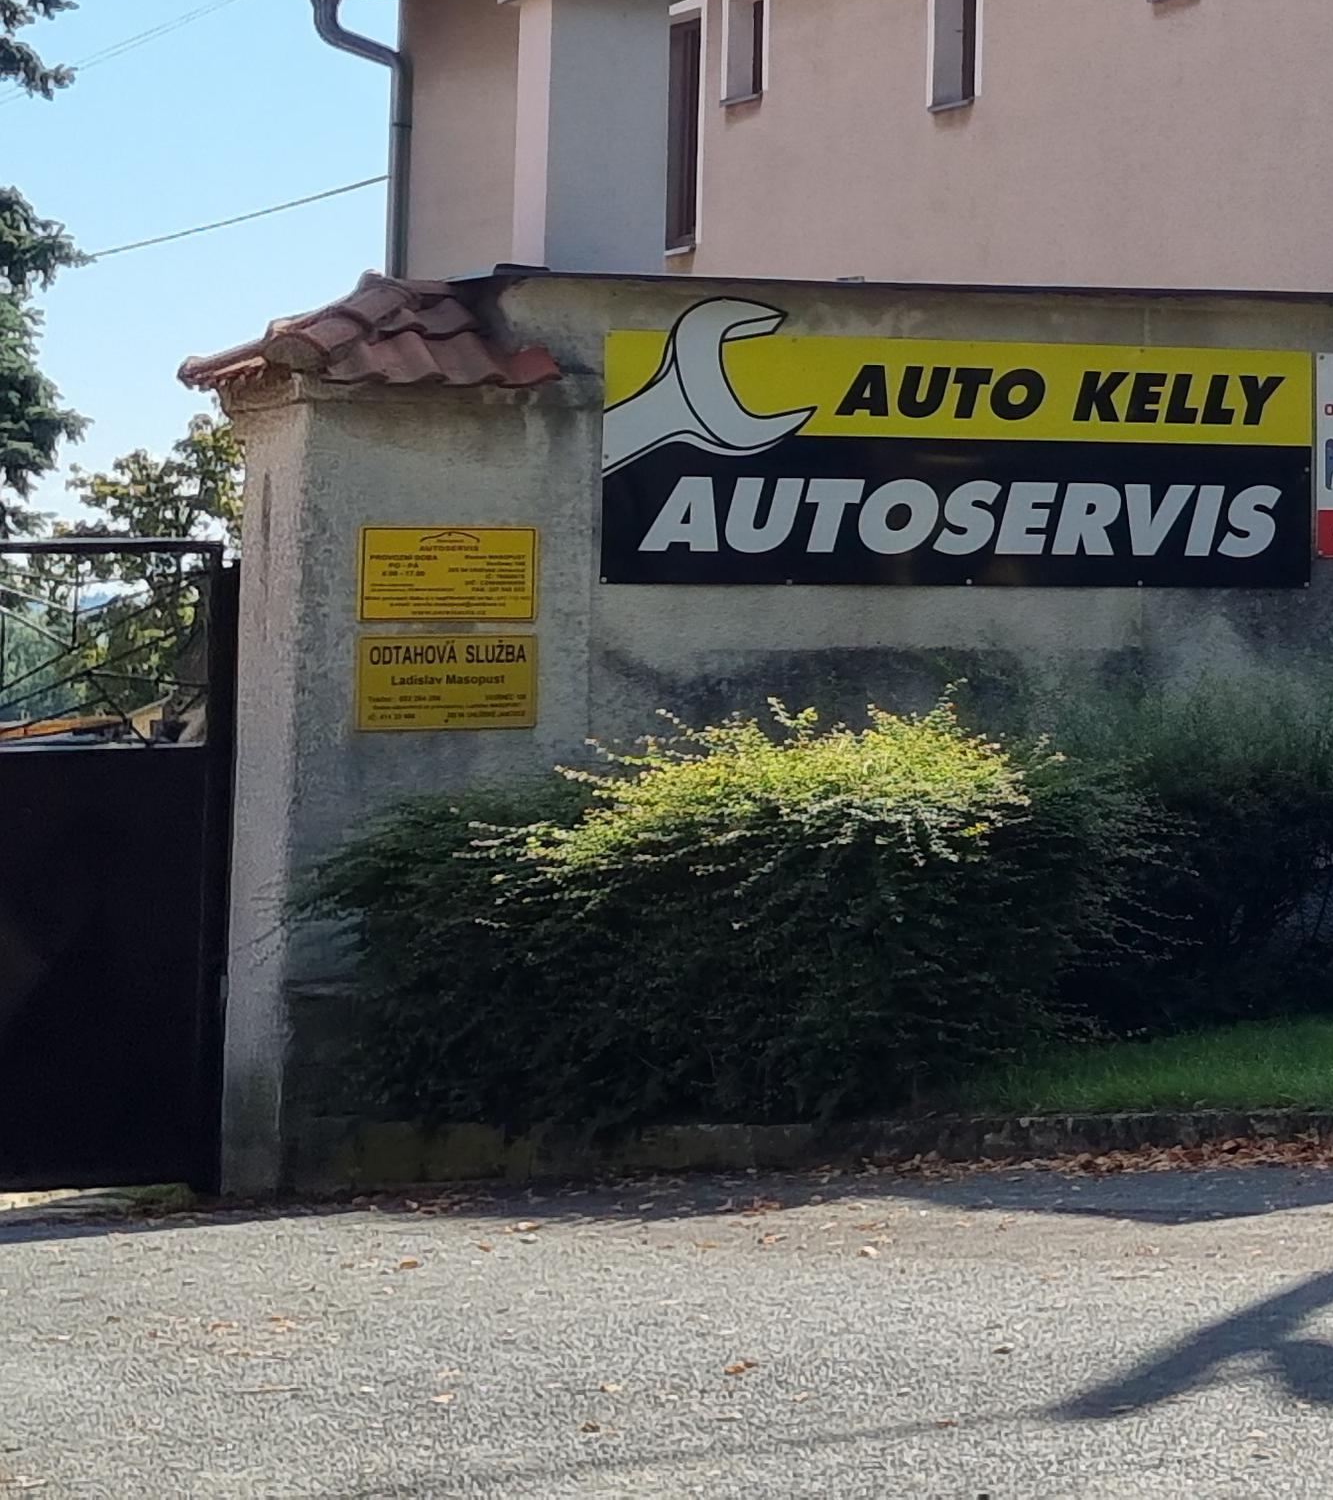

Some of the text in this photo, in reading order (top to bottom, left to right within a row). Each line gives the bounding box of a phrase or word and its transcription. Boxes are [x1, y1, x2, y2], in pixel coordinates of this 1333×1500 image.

[835, 364, 1286, 426] AUTO KELLY
[638, 475, 1282, 558] AUTOSERVIS
[369, 640, 527, 665] ODTAHOVÁ SLUŽBA
[391, 674, 505, 686] Ladislav Masopust
